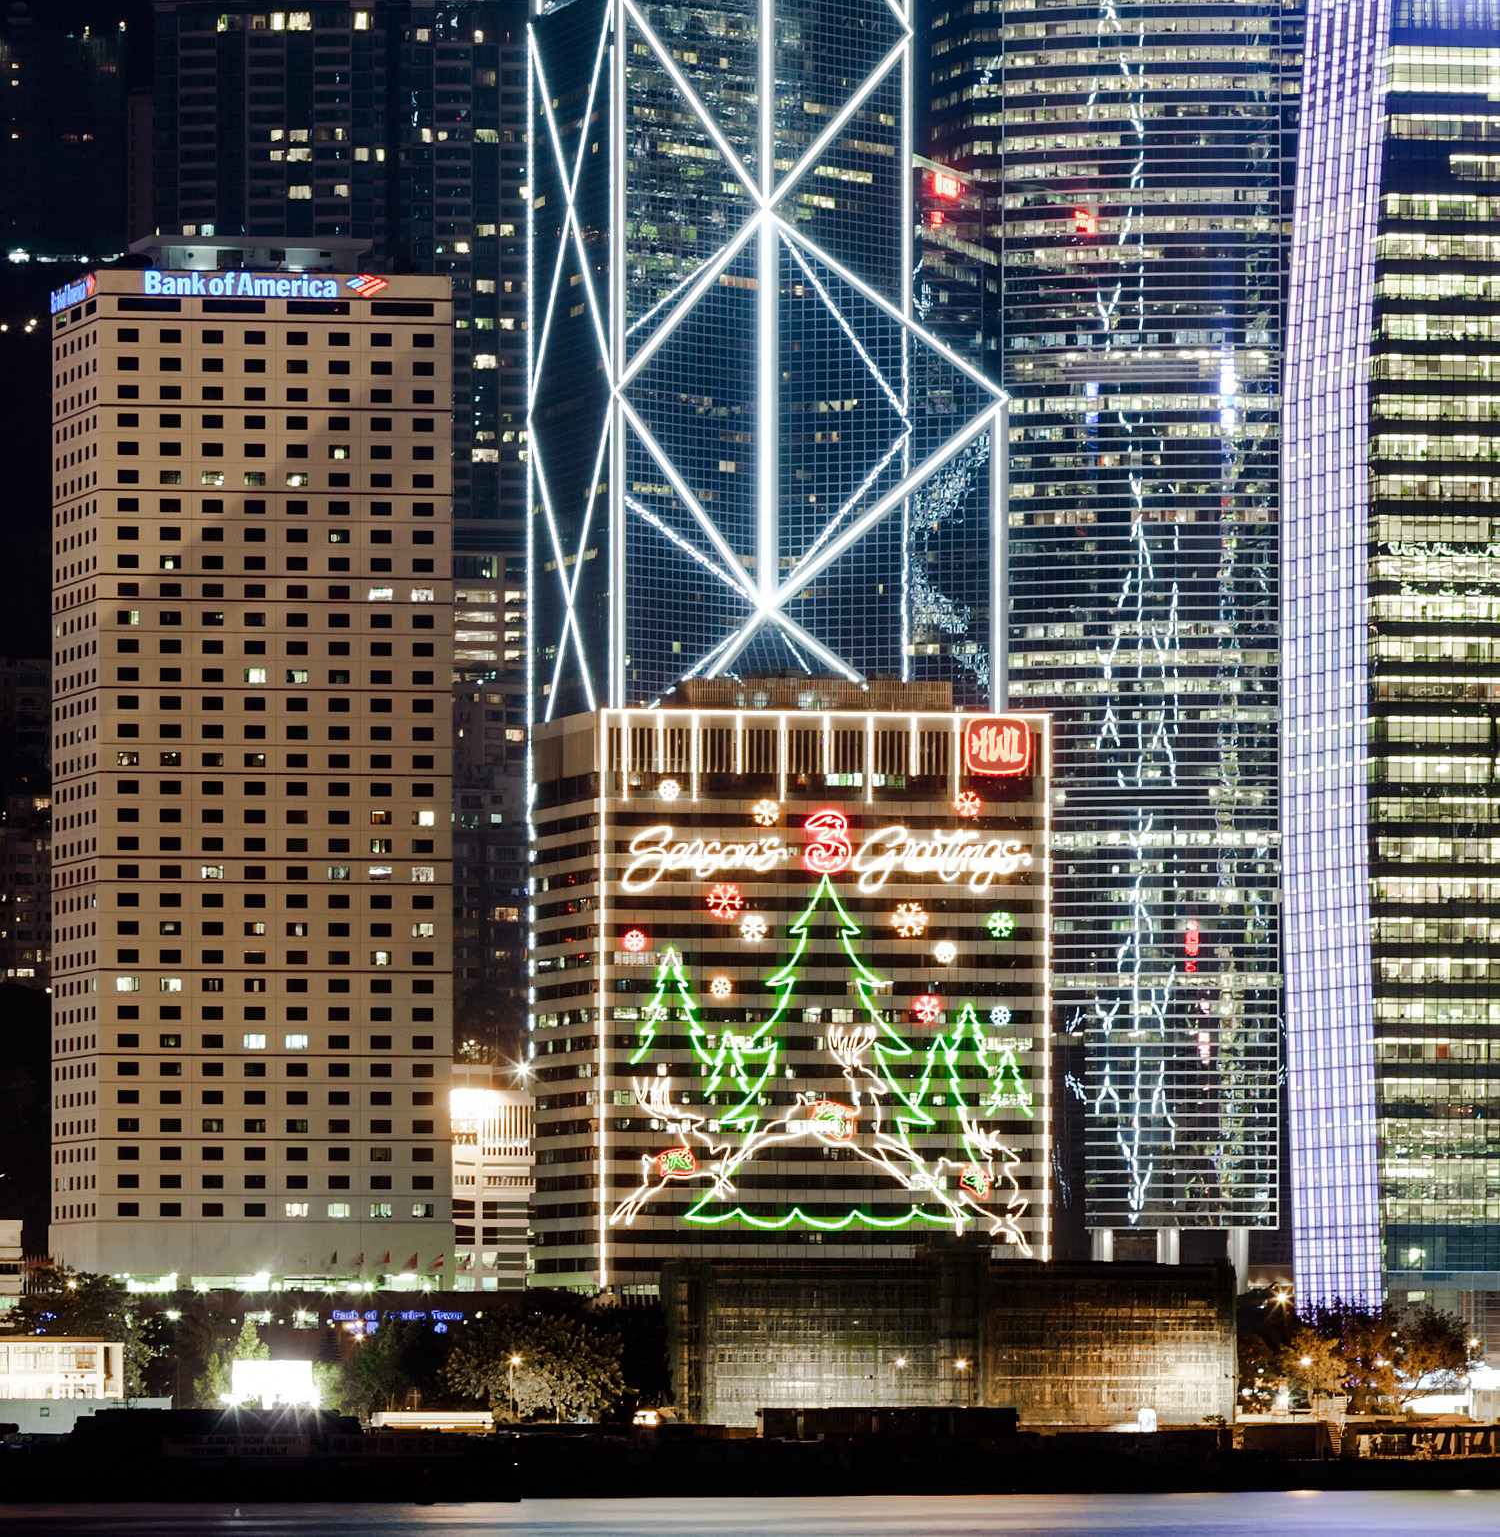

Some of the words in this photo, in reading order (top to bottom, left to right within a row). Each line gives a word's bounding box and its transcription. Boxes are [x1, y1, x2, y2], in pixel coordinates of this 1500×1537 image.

[144, 270, 207, 296] Bank
[208, 271, 235, 296] of
[236, 272, 338, 298] America
[621, 825, 788, 893] Season's
[851, 825, 1032, 893] Greetings
[332, 1309, 360, 1321] Bank
[364, 1309, 378, 1321] of
[431, 1309, 464, 1321] Tower
[190, 1446, 228, 1456] WORK
[241, 1446, 289, 1456] SAFELY
